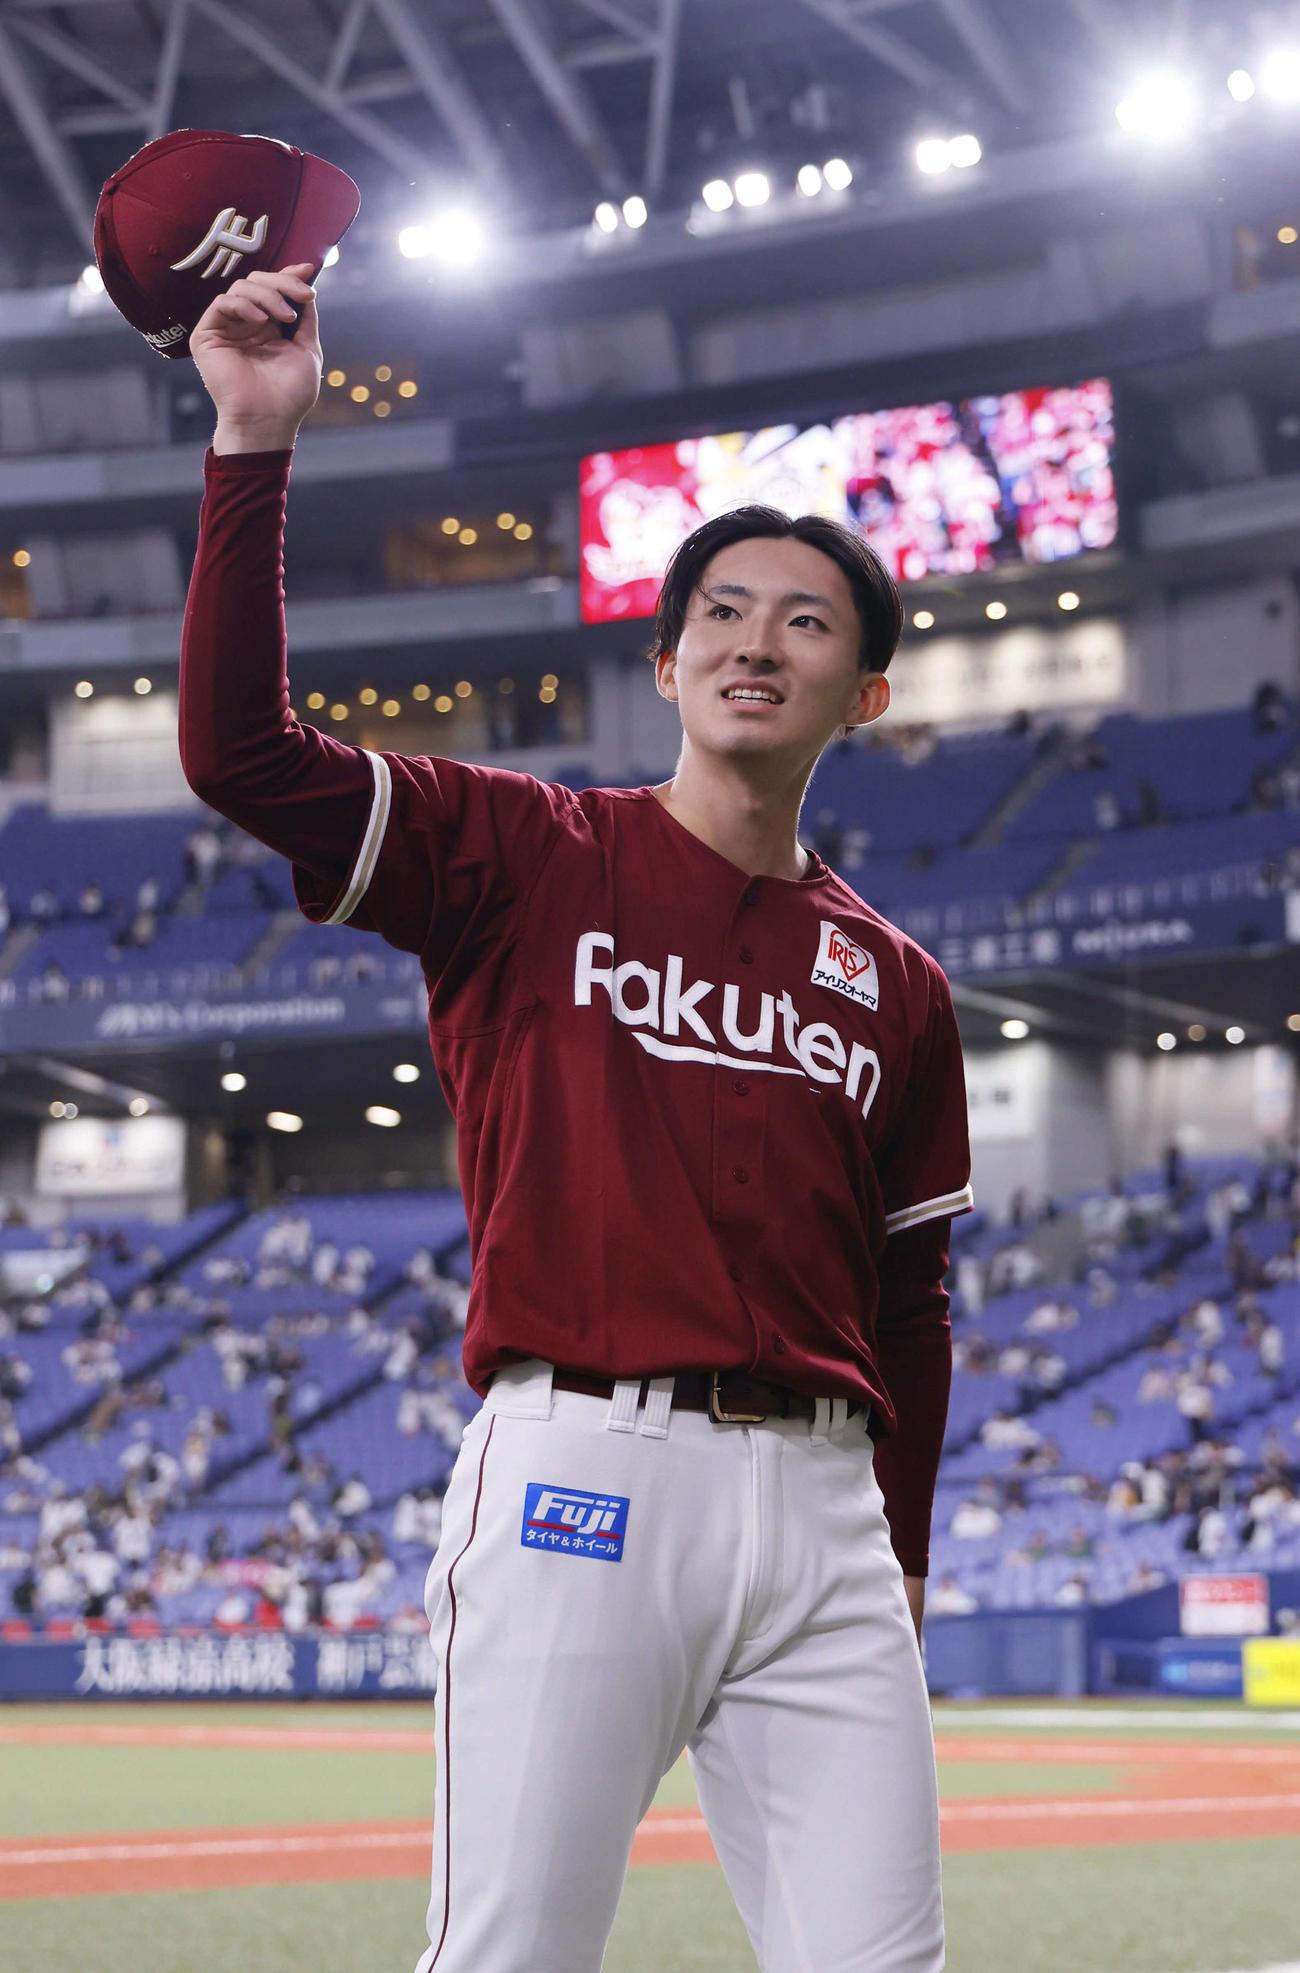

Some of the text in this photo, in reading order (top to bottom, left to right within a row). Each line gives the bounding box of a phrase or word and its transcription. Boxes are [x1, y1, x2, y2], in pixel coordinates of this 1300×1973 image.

[828, 937, 857, 972] IRIS
[813, 969, 876, 1007] アイリスオーヤマ
[575, 931, 881, 1120] Rakuten
[532, 1491, 621, 1534] Fuji
